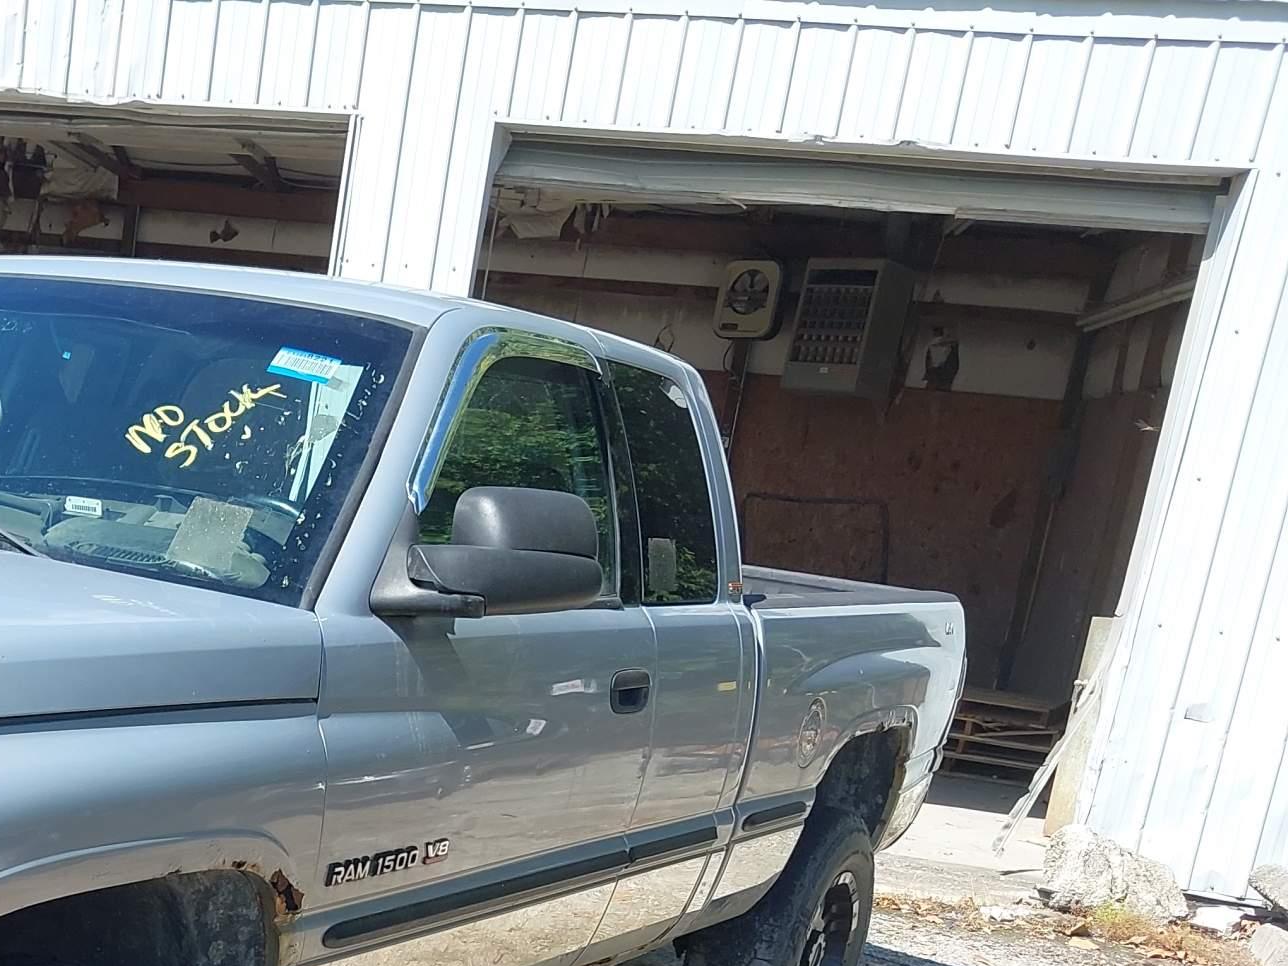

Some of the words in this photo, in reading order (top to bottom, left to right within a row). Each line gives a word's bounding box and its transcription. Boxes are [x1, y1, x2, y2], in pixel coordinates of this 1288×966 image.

[325, 856, 371, 886] RAM
[374, 846, 420, 875] 1500
[425, 838, 450, 860] V8
